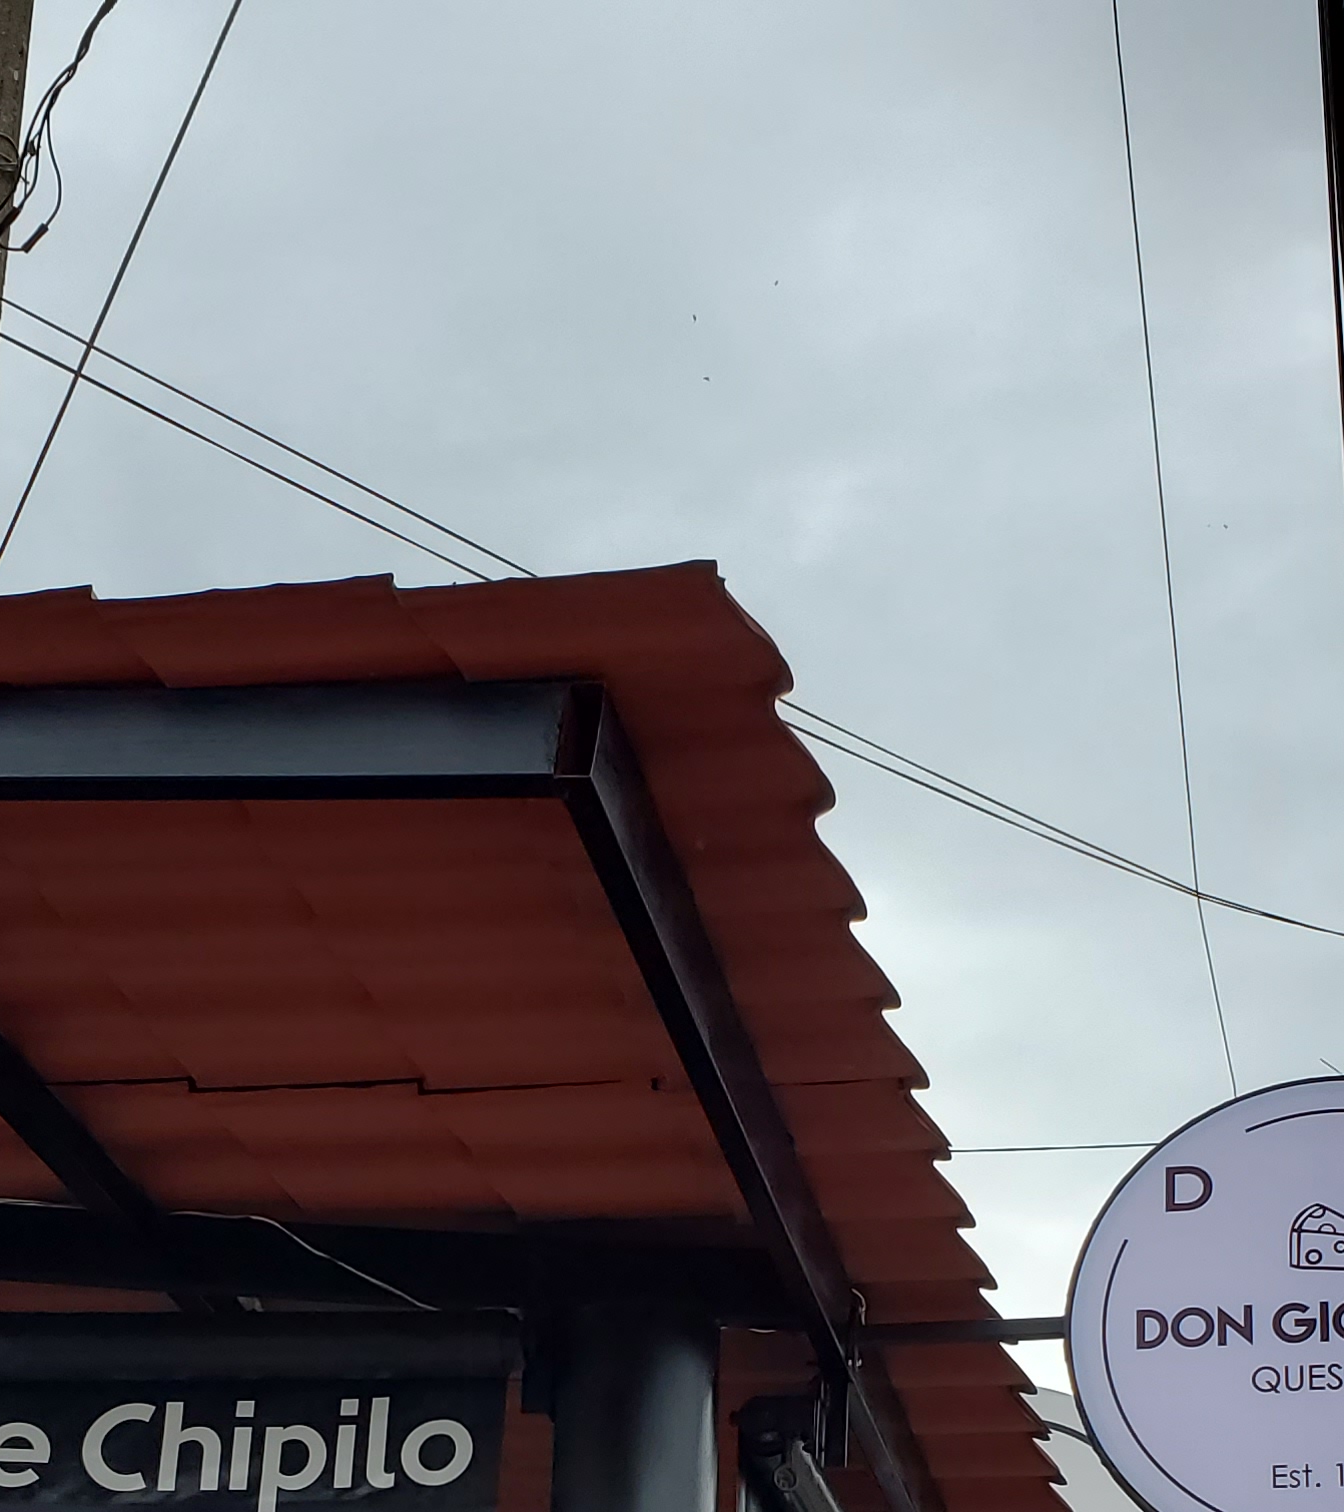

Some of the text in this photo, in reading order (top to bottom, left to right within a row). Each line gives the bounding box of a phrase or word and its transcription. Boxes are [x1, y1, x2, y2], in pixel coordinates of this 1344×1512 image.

[1164, 1165, 1214, 1213] D
[1135, 1303, 1254, 1351] DON
[1271, 1463, 1323, 1490] Est.
